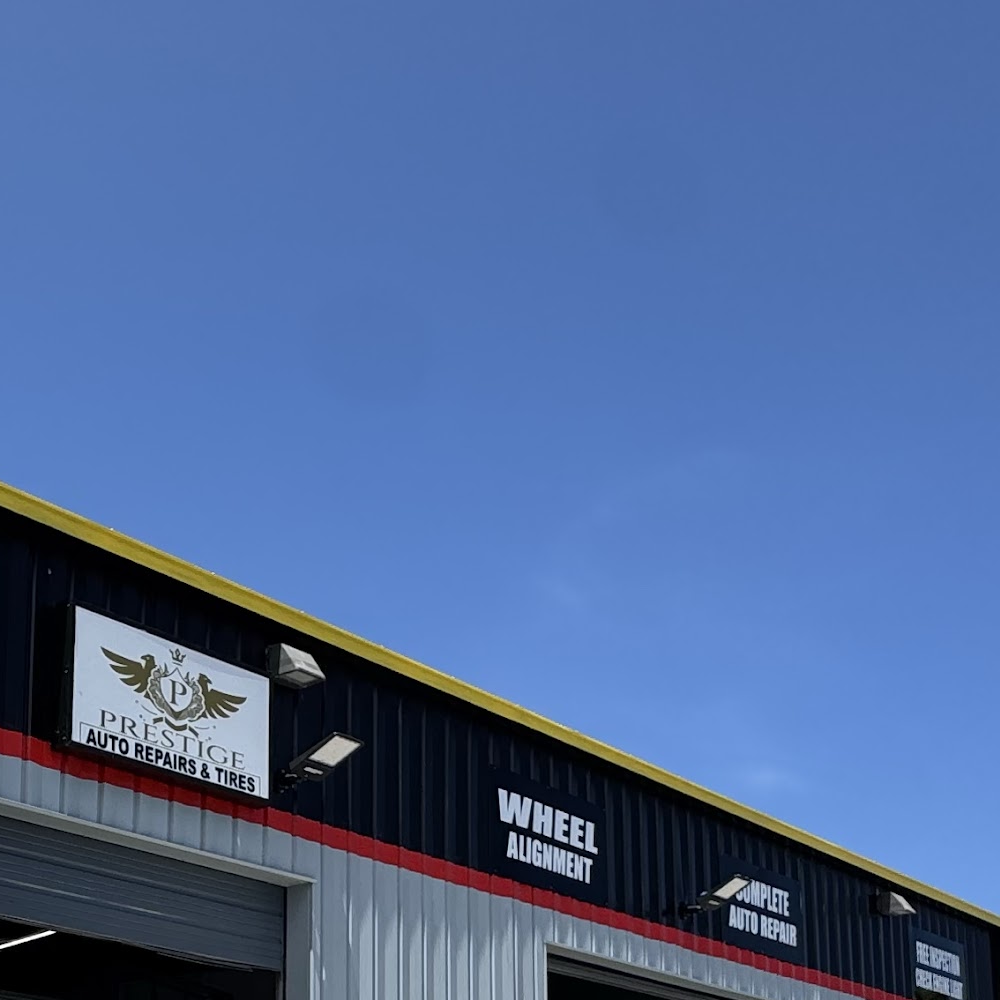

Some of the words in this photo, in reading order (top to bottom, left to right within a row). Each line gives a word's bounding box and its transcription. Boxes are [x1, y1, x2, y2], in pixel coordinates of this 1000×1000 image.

[168, 679, 187, 706] P
[86, 728, 130, 756] AUTO
[134, 742, 197, 776] REPAIRS
[200, 762, 211, 780] &
[214, 766, 256, 793] TIRES
[99, 708, 246, 771] PRESTIGE
[497, 787, 599, 856] WHEEL
[506, 830, 594, 885] ALIGNMENT
[728, 904, 759, 935] AUTO
[760, 914, 798, 948] REPAIR
